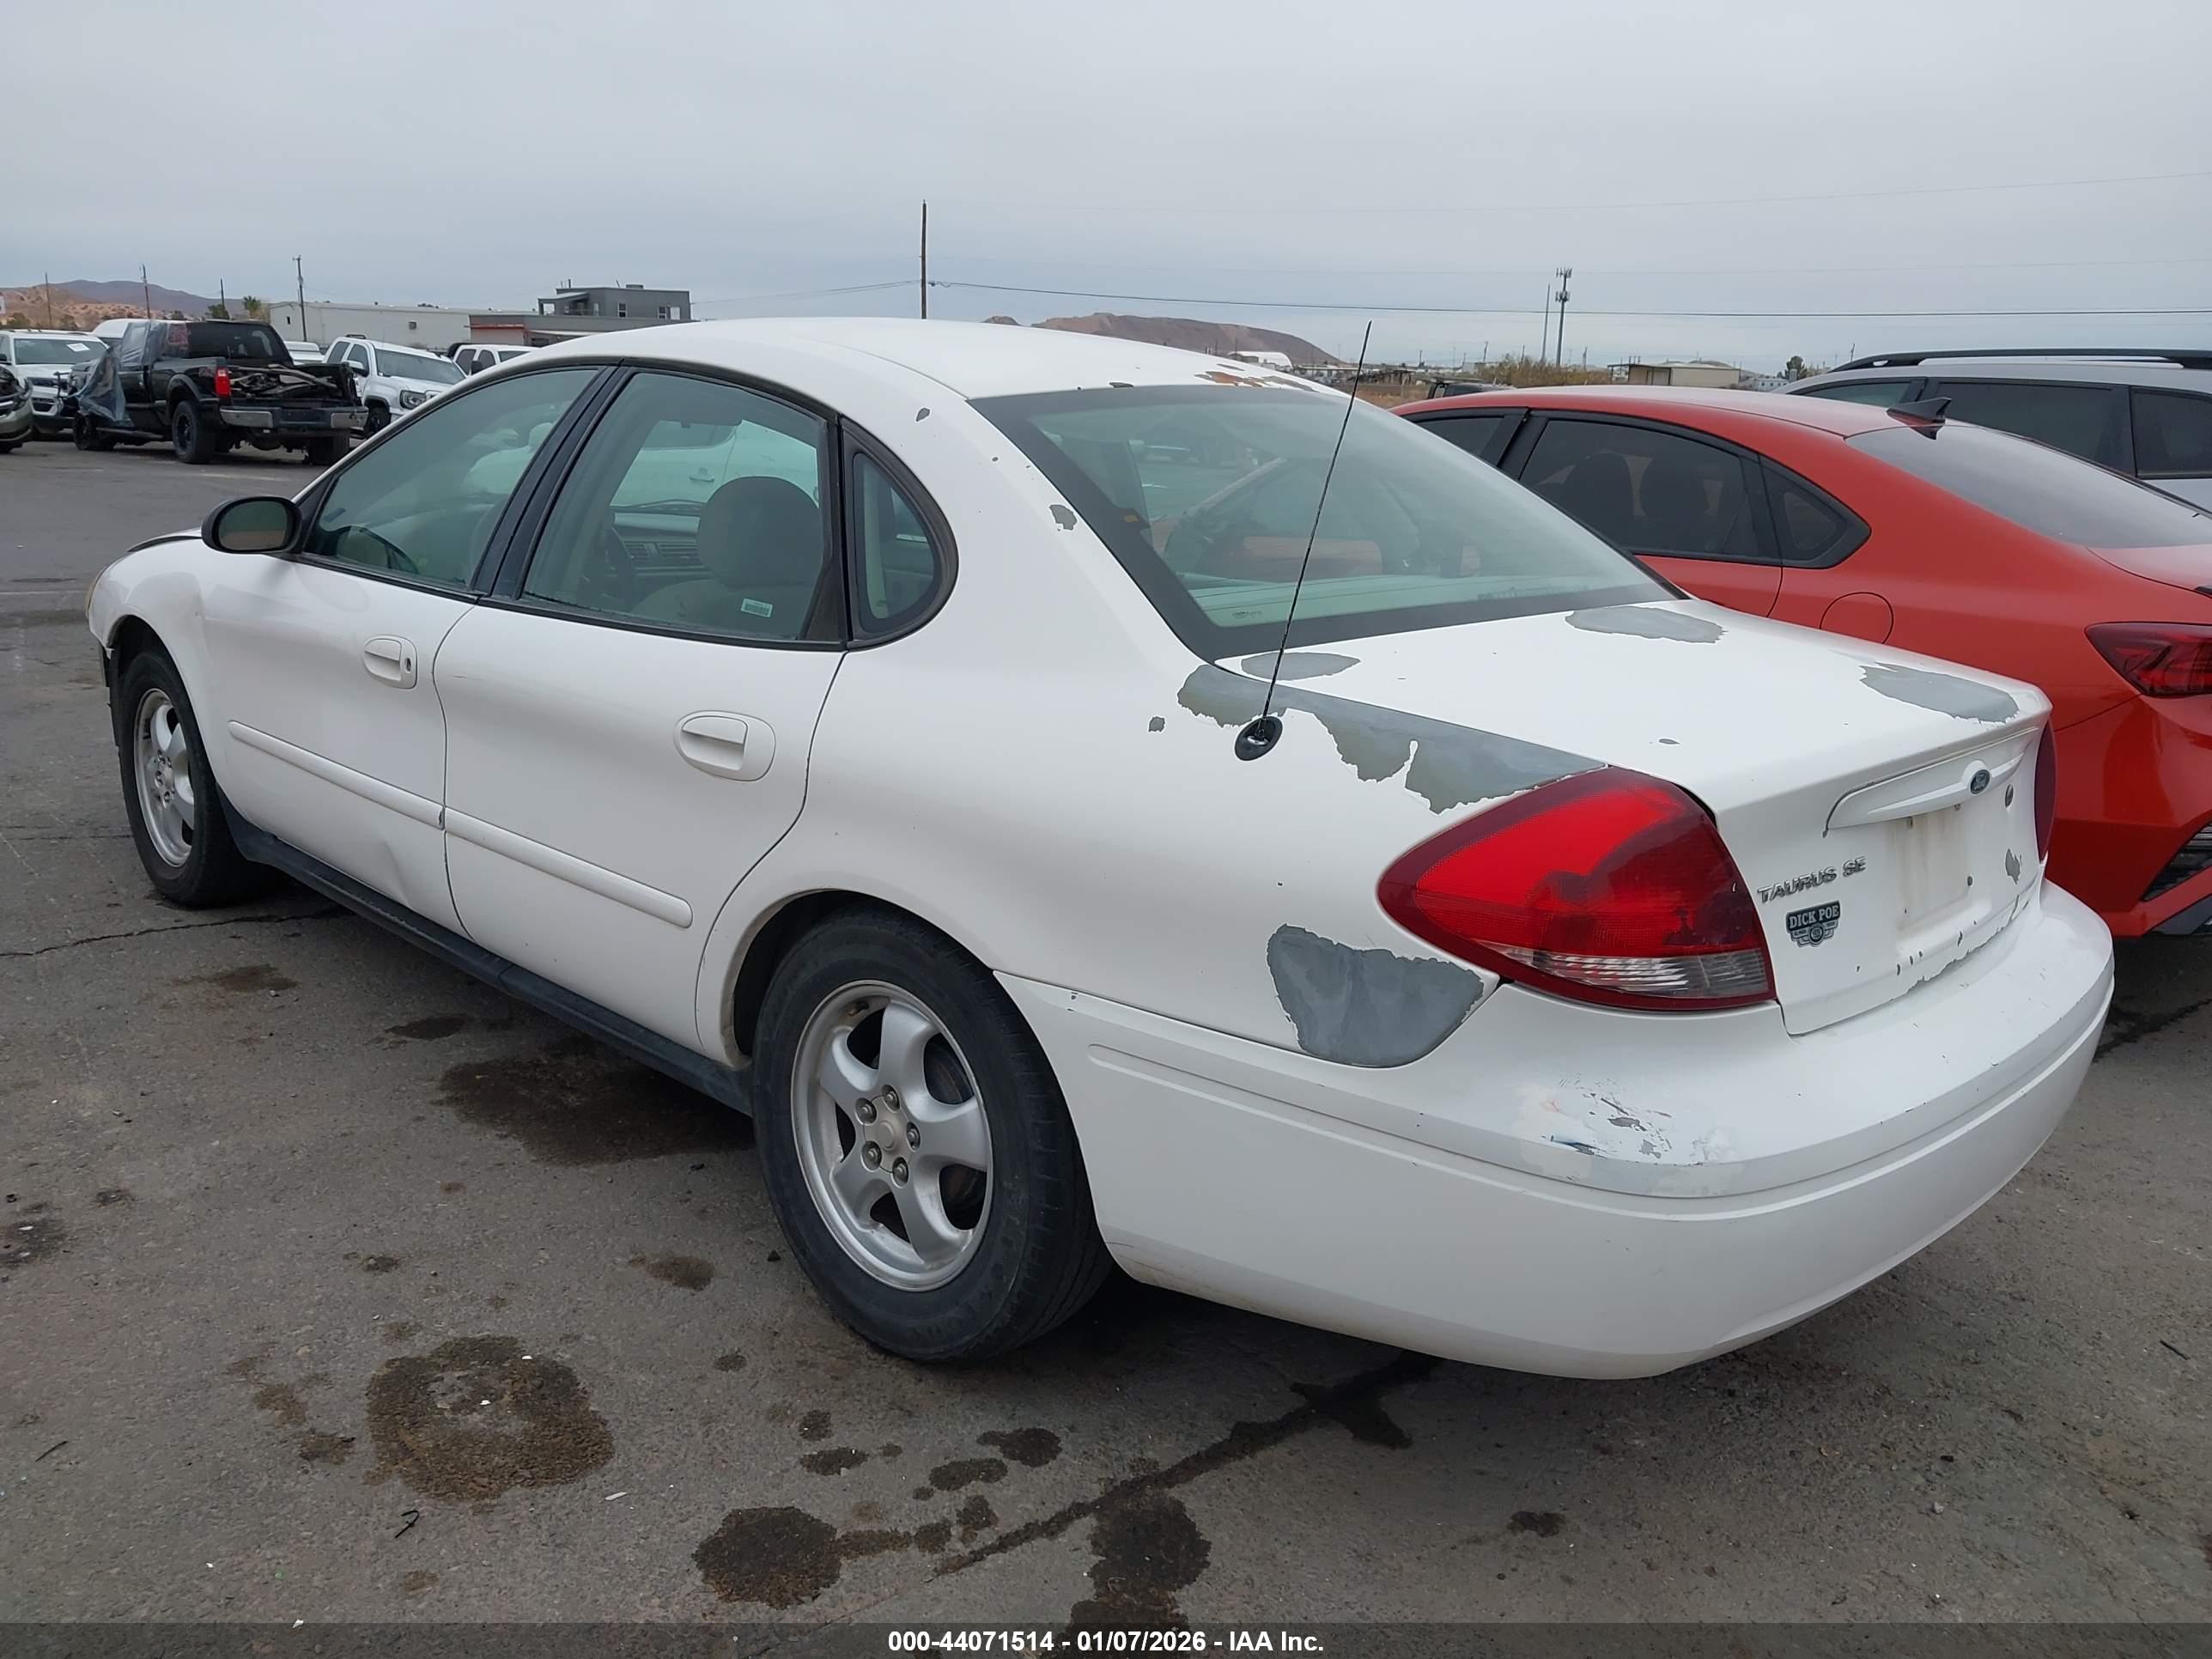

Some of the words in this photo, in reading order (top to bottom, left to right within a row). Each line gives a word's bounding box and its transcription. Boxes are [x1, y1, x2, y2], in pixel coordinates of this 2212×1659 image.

[1757, 866, 1837, 902] TAURUS
[1843, 856, 1866, 877] SE
[1789, 910, 1817, 929] DICK
[1818, 905, 1839, 921] POE
